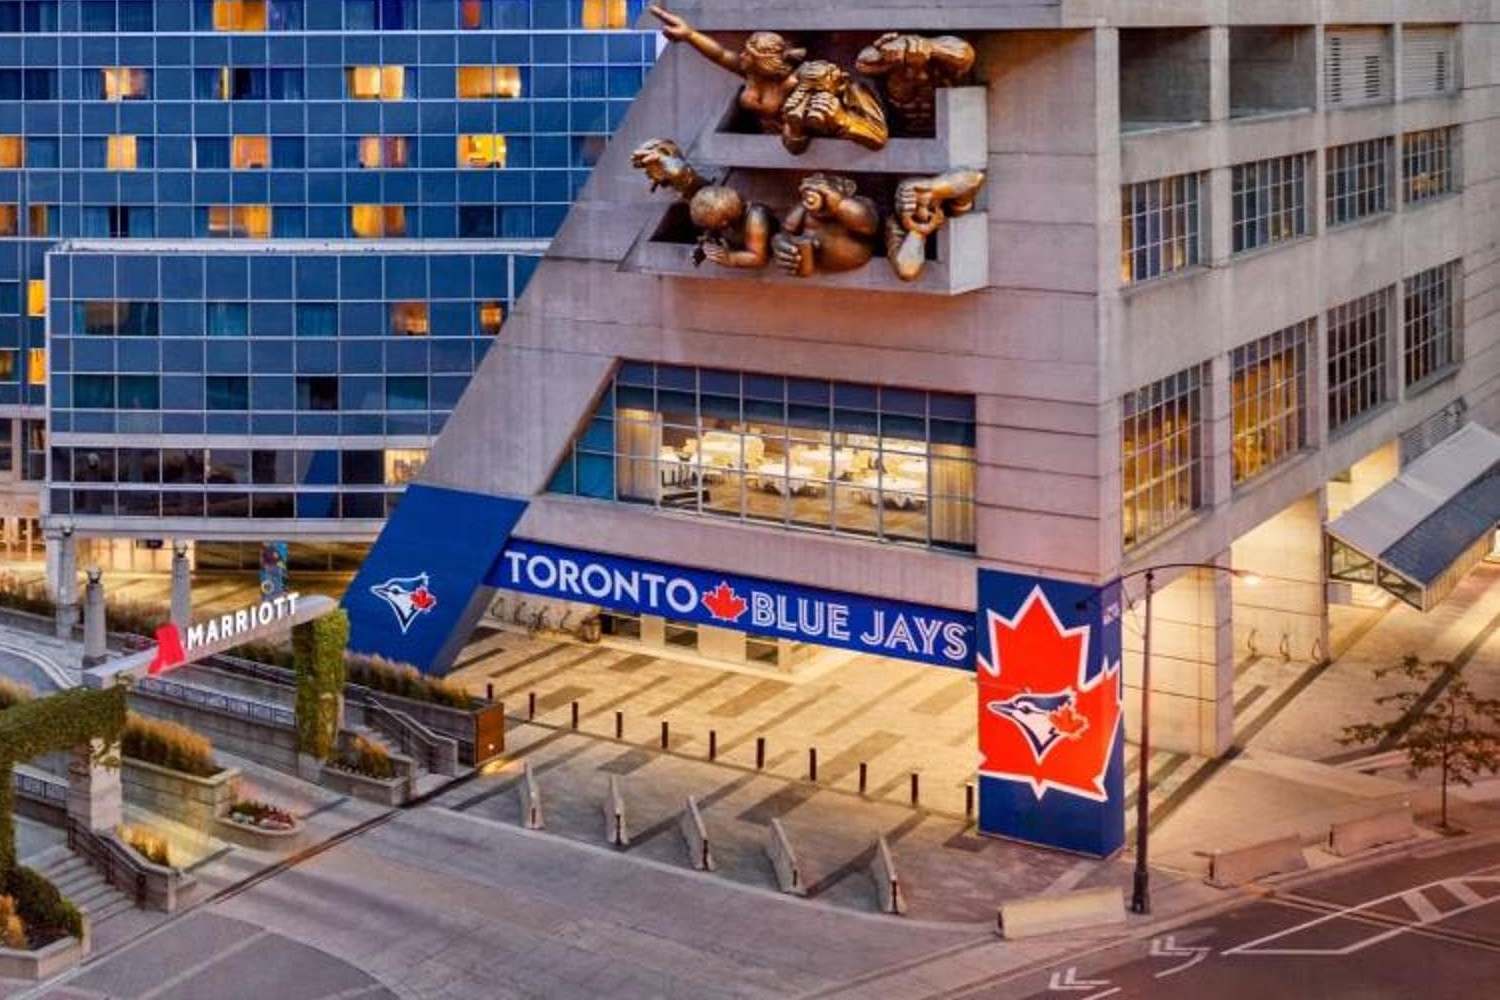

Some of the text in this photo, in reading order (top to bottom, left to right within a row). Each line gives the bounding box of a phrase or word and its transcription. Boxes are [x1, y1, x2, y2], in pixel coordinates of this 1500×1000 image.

[186, 592, 299, 651] MARRIOTT
[504, 551, 968, 661] TORONTO BLUE JAYS
